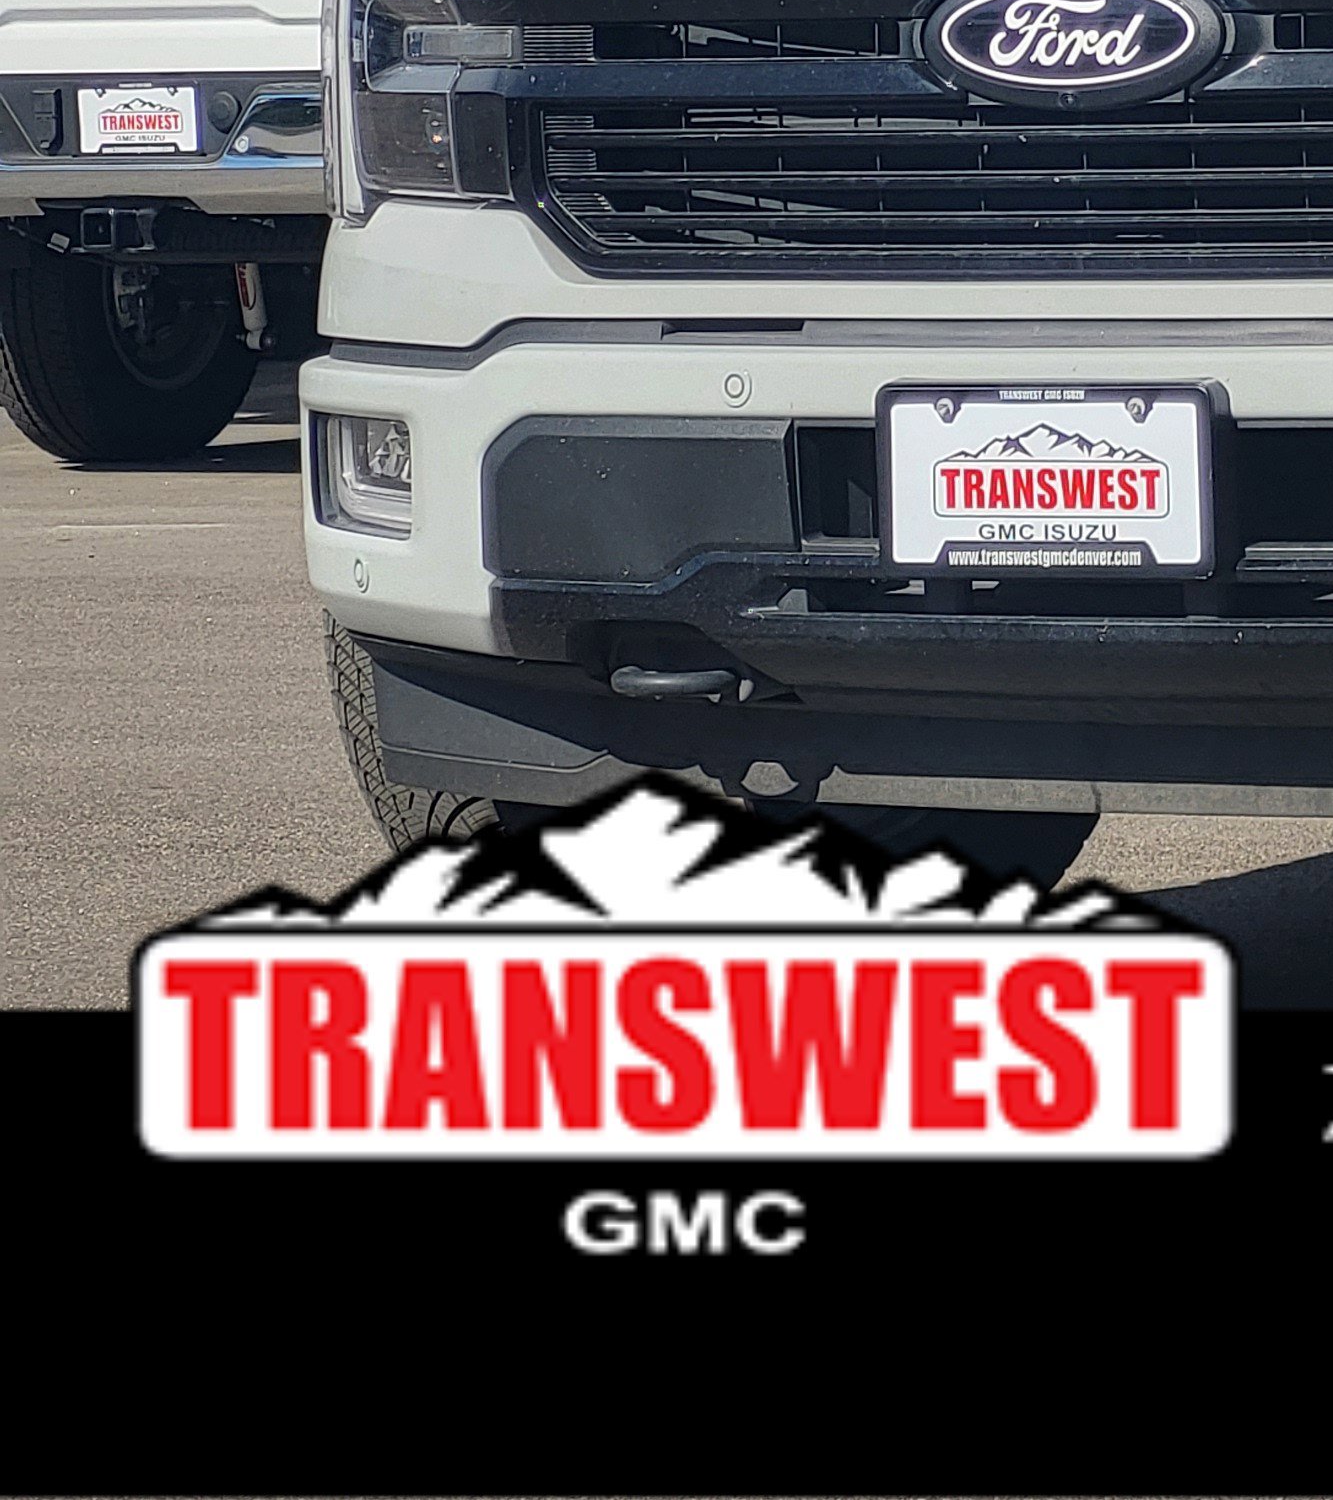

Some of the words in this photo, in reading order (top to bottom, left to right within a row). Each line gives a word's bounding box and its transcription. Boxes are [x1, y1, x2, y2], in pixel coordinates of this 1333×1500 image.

[101, 115, 179, 131] TRANSWEST
[999, 390, 1043, 400] TRANSWEST
[1044, 390, 1062, 400] GMC
[1063, 390, 1085, 400] ISUZU
[940, 468, 1161, 510] TRANSWEST
[979, 524, 1034, 540] GMC
[1044, 524, 1117, 541] ISUZU
[948, 549, 1141, 567] www.transwestgmcdenver.com
